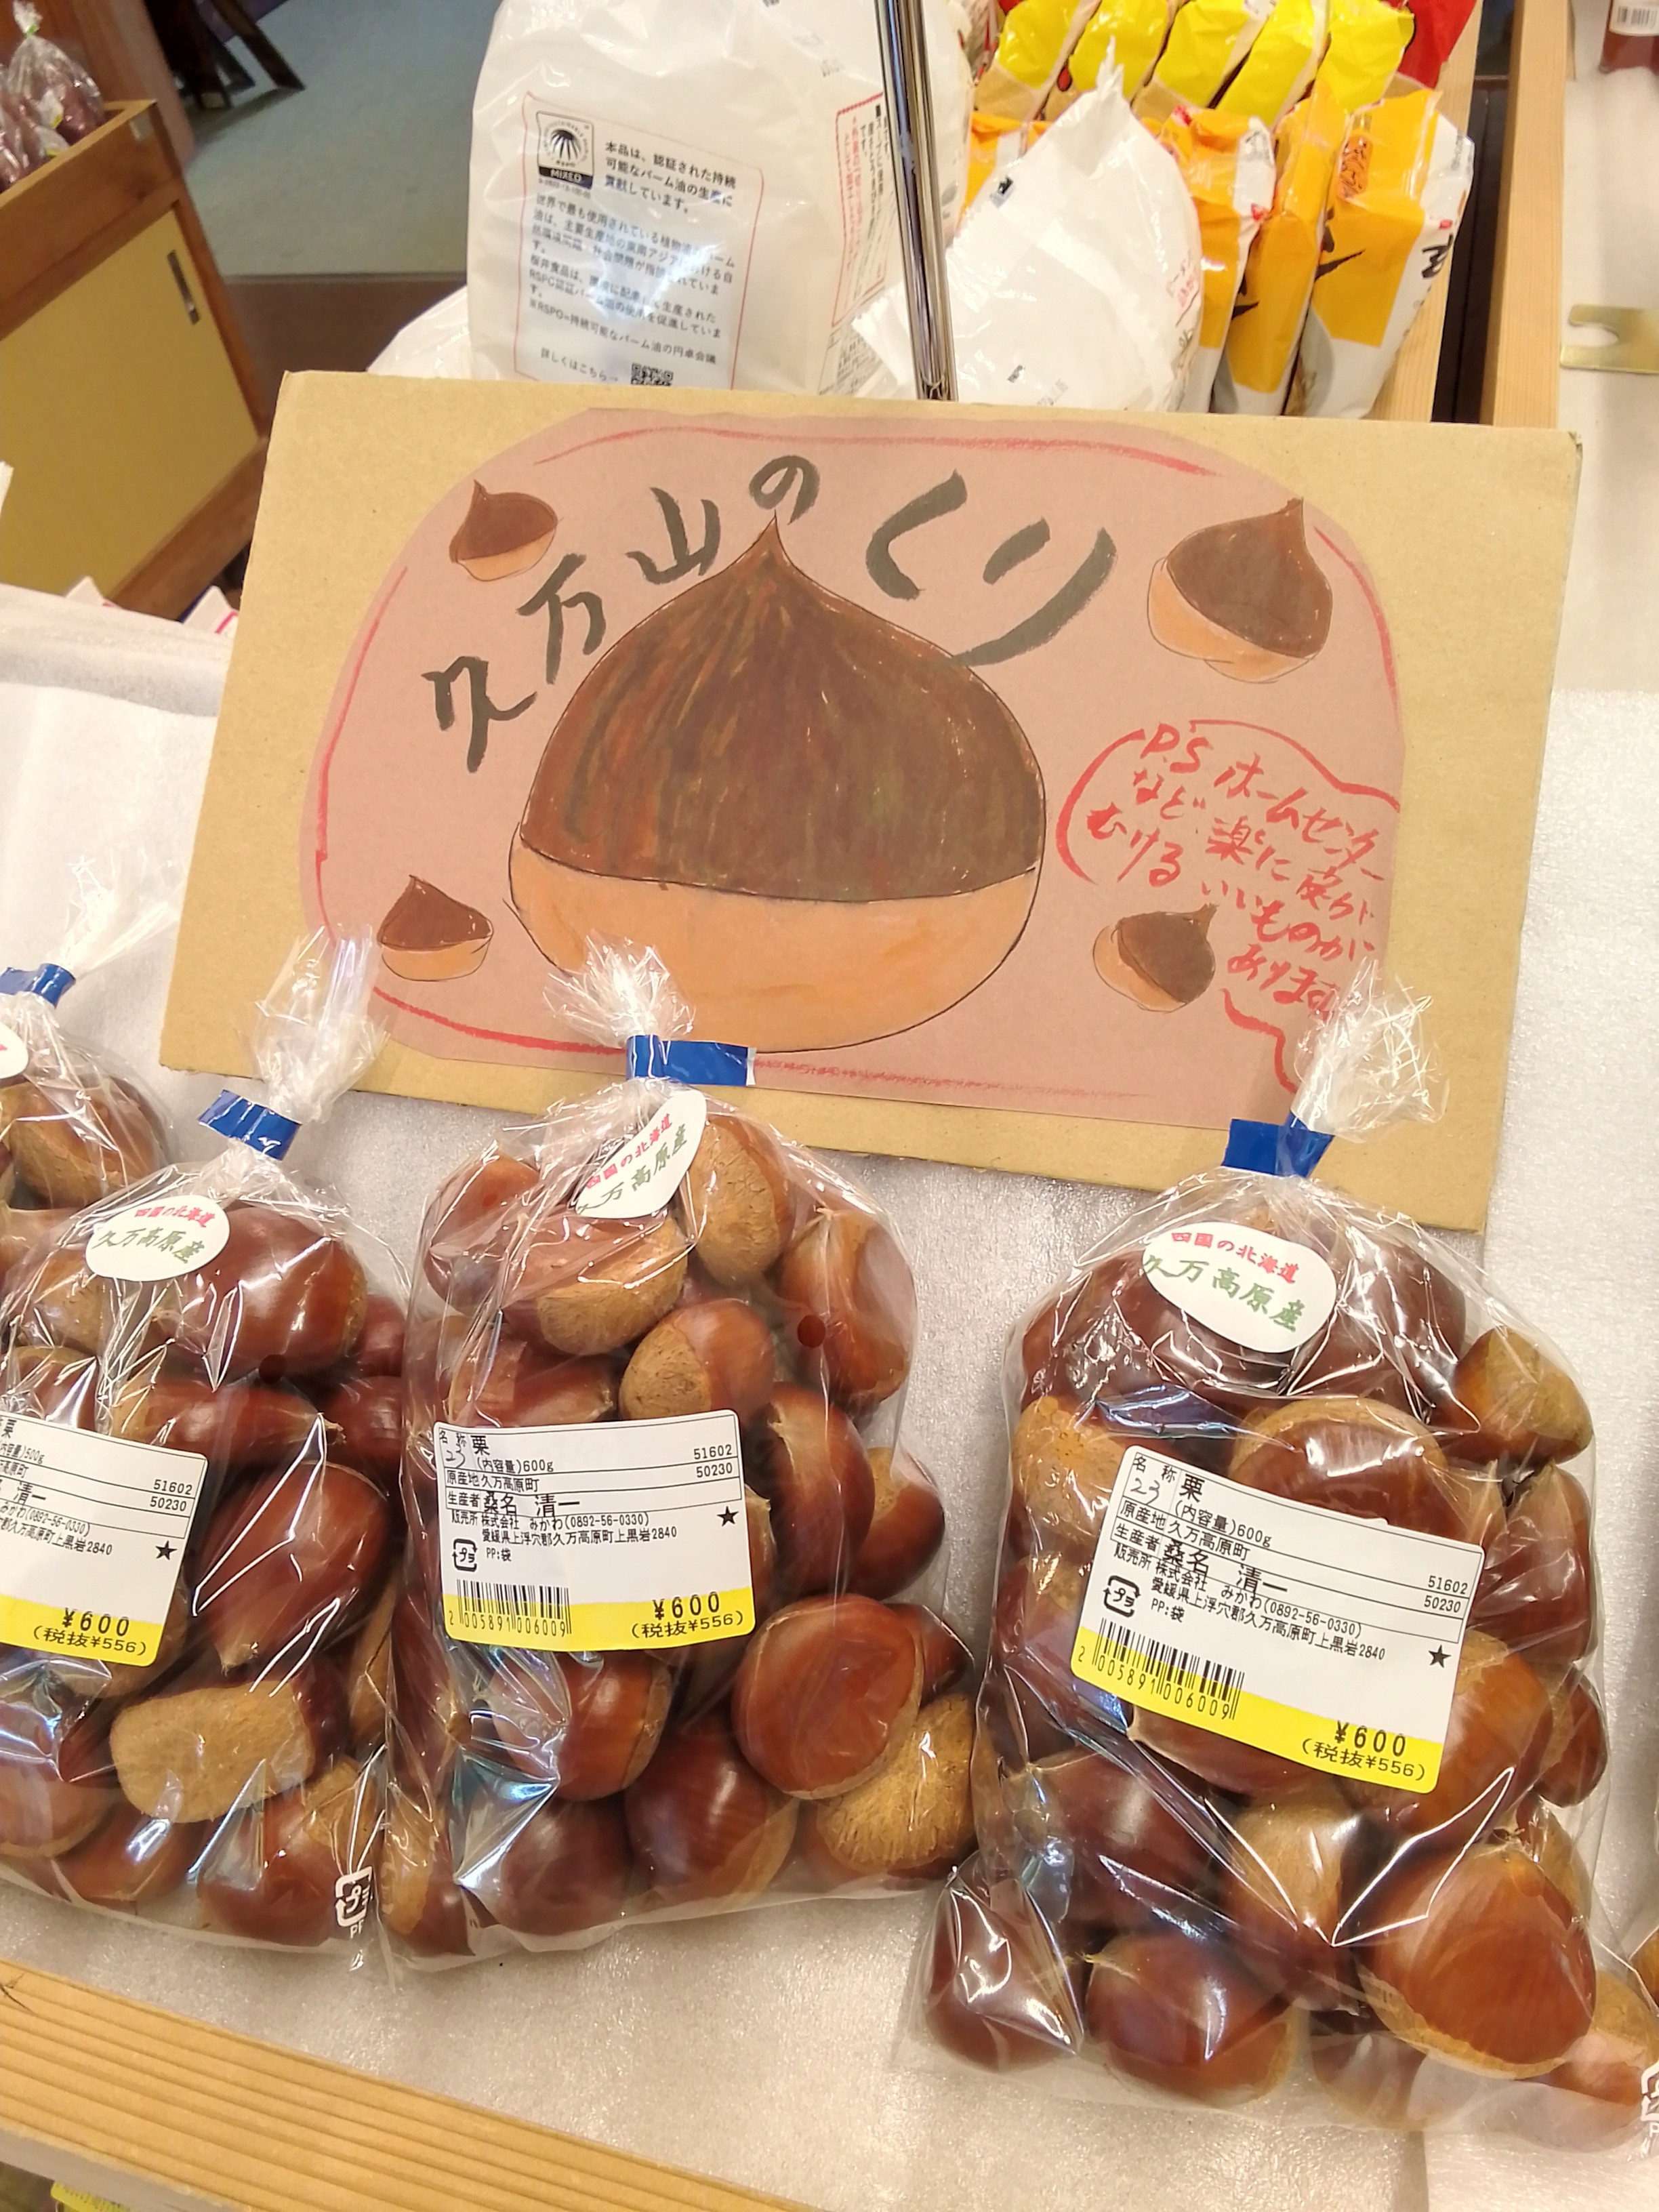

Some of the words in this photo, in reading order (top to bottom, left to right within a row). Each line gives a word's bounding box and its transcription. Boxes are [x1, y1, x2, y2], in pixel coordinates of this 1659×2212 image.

[550, 169, 583, 183] MIXED
[91, 1227, 206, 1264] 久万高原産
[1171, 1232, 1300, 1284] 四国の北海道
[1142, 1254, 1306, 1333] 久万高原産
[470, 1435, 491, 1456] 栗
[477, 1456, 554, 1474] (内容量)600g
[694, 1444, 733, 1460] 51602
[0, 1459, 29, 1479] 高原町
[150, 1496, 188, 1513] 50230
[153, 1478, 193, 1496] 51602
[447, 1469, 480, 1487] 原産地
[480, 1474, 540, 1493] 久万高原町
[695, 1462, 734, 1479] 50230
[1179, 1473, 1206, 1503] 栗
[447, 1491, 480, 1508] 生産者
[0, 1516, 113, 1557] 郡久万高原町上黒岩2840
[481, 1527, 678, 1547] 愛媛県上浮穴郡久万高原町上黒岩2840
[1113, 1522, 1162, 1553] 生産者
[1174, 1499, 1273, 1549] (内容量)600g
[1427, 1574, 1469, 1596] 51602
[1120, 1499, 1167, 1532] 原産地
[1167, 1519, 1251, 1562] 久万高原町
[1423, 1593, 1463, 1614] 50230
[62, 1607, 130, 1637] ¥600
[653, 1591, 722, 1622] ¥600
[1151, 1576, 1387, 1662] 愛媛県上浮穴郡久万高原町上黒岩2840
[33, 1625, 148, 1656] (税抜¥556)
[632, 1610, 745, 1640] (税抜¥556)
[1334, 1719, 1407, 1758] ¥600
[1301, 1737, 1427, 1782] (税抜¥556)
